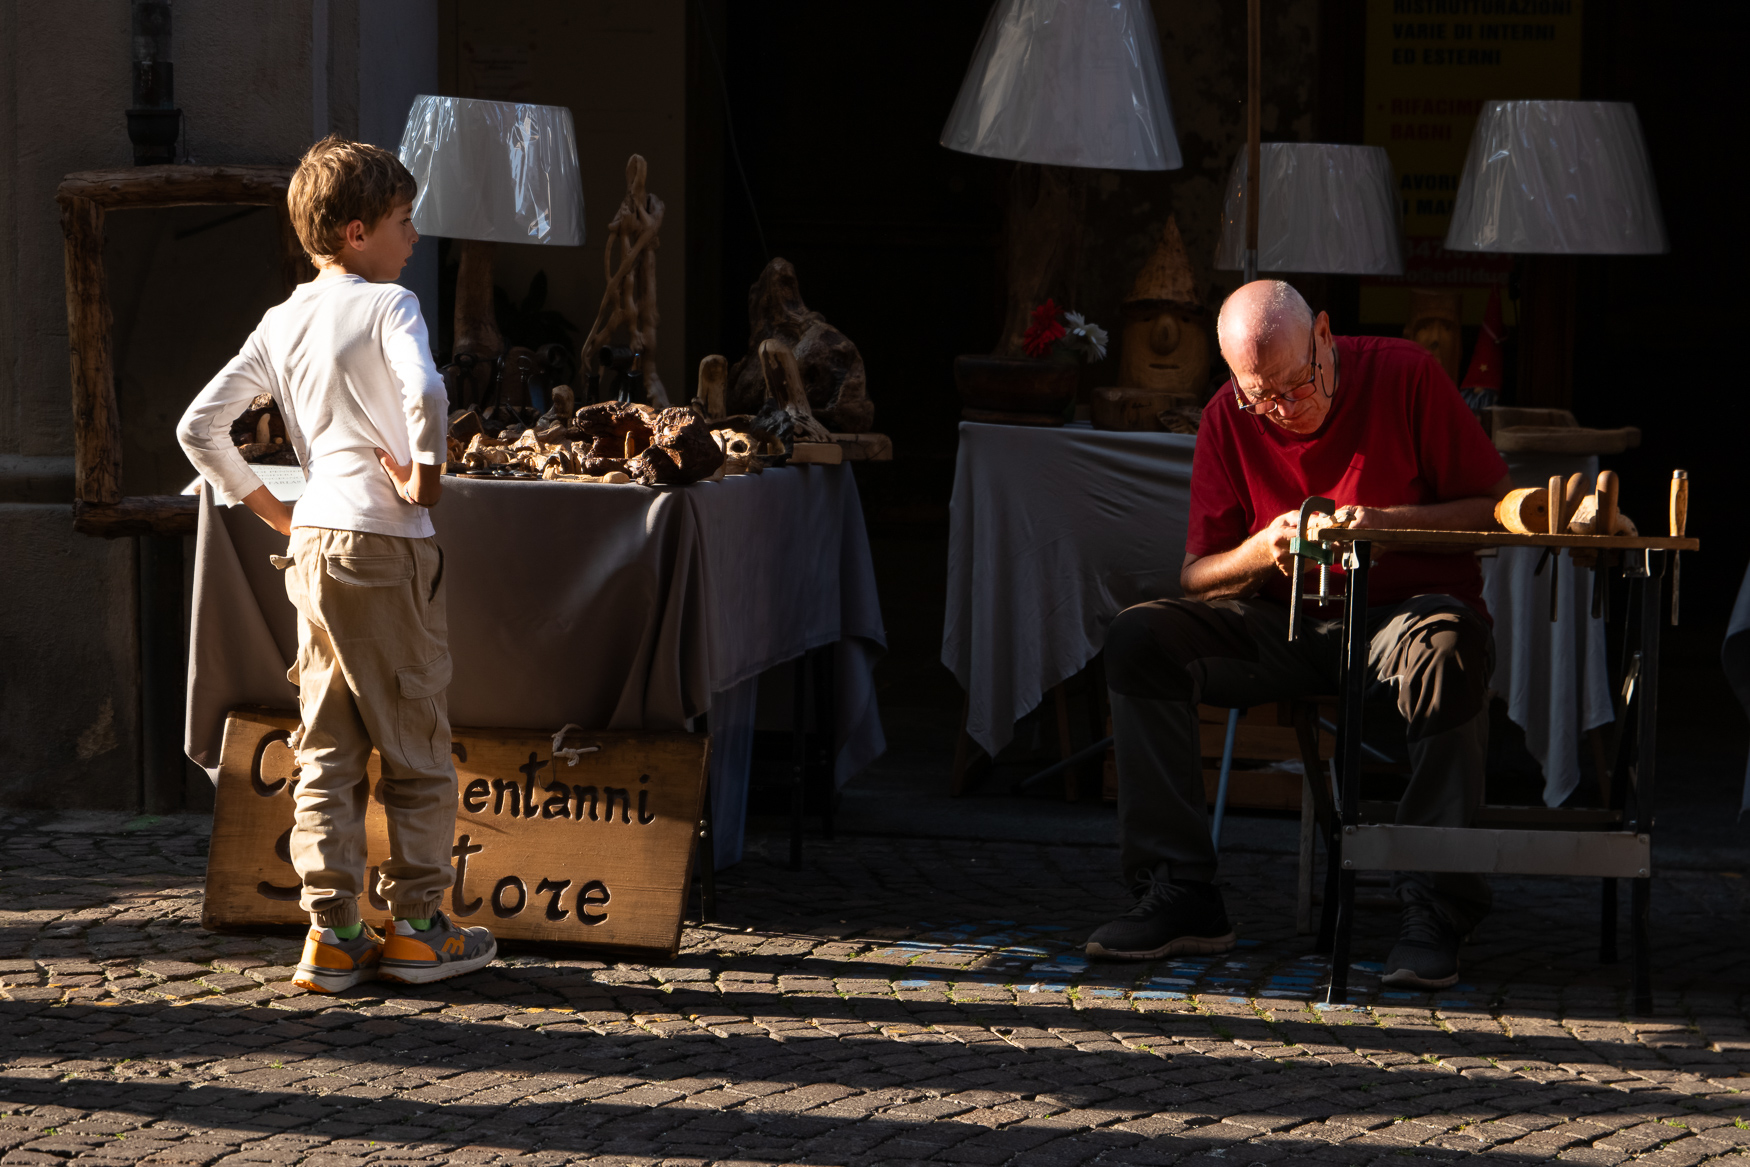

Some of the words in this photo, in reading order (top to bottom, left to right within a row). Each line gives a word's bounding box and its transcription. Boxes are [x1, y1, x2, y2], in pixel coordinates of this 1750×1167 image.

[1393, 0, 1572, 15] RISTRUTTURAZIONI
[1392, 23, 1446, 40] VARIE
[1453, 24, 1473, 40] DI
[1479, 24, 1556, 41] INTERNI
[1392, 48, 1416, 65] ED
[1422, 48, 1502, 65] ESTERNI
[1390, 124, 1452, 140] BAGNI
[1401, 174, 1457, 191] AVORI
[451, 741, 656, 826] entanni
